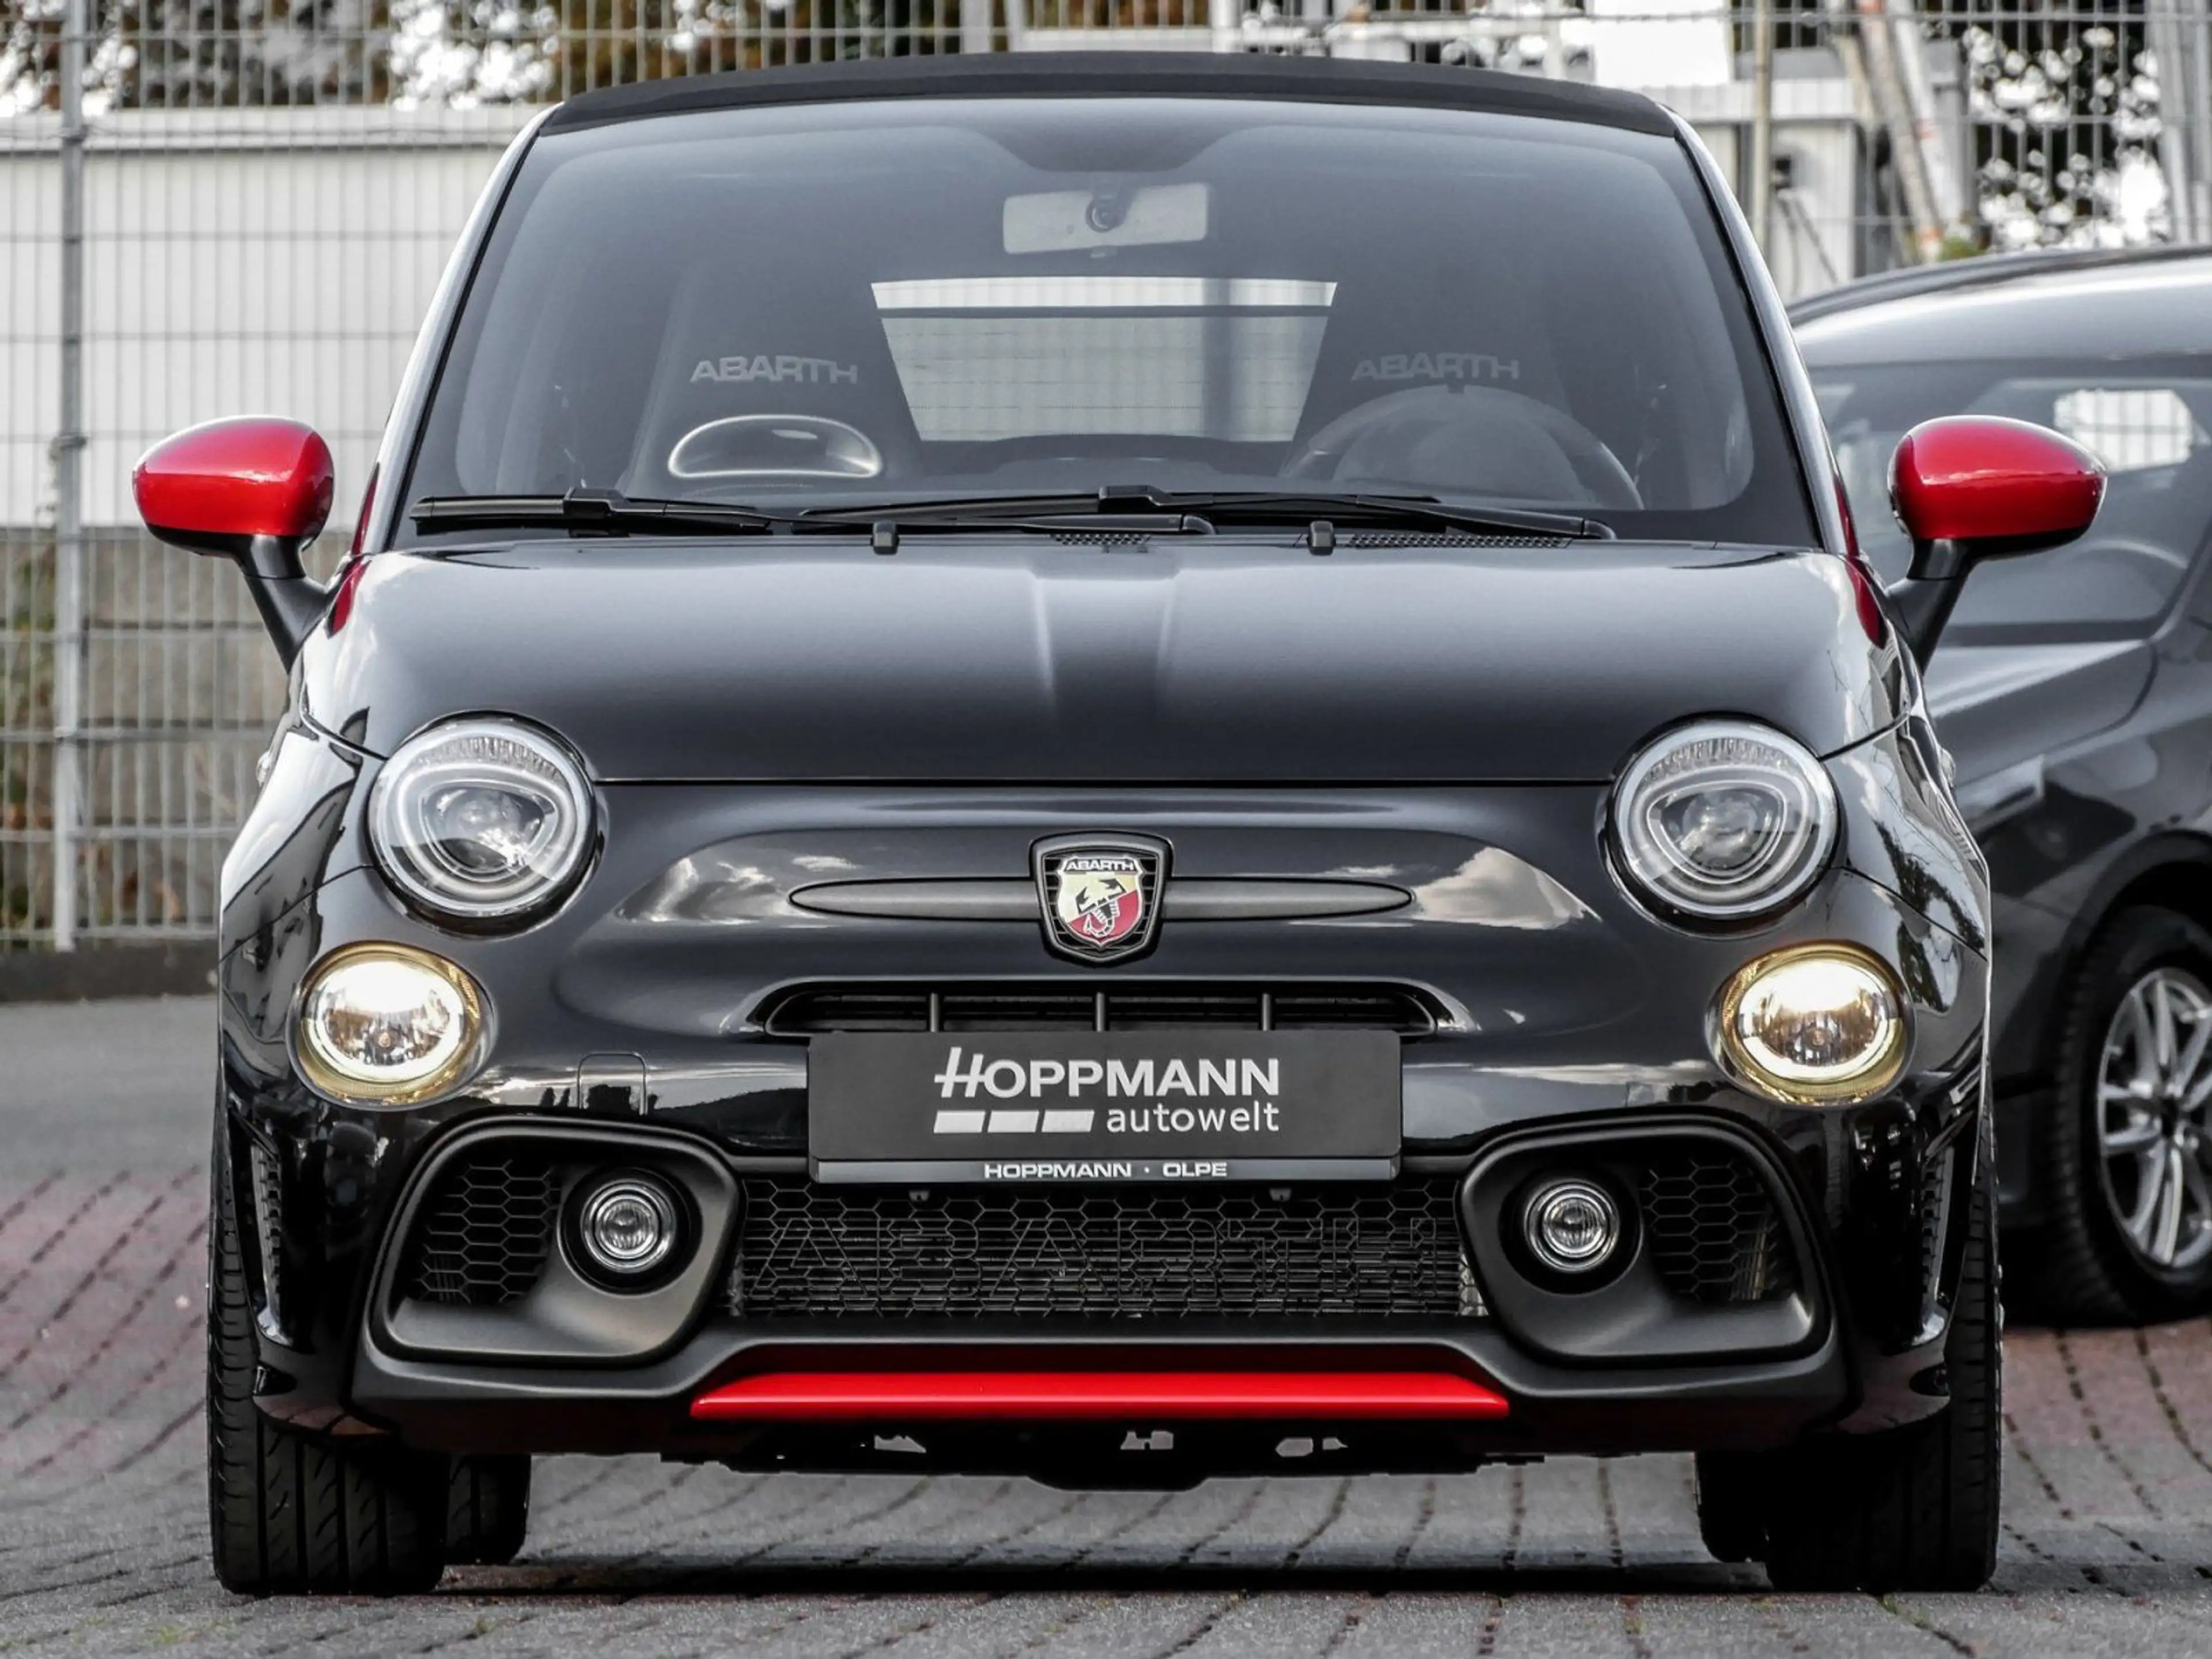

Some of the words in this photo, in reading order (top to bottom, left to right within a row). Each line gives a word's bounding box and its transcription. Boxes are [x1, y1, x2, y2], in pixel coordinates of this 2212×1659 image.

[690, 355, 858, 384] ABARTH
[1351, 351, 1520, 381] ABARTH
[1066, 859, 1133, 870] ABARTH
[934, 1046, 1279, 1099] HOPPMANN
[1107, 1100, 1279, 1133] autowelt
[984, 1162, 1132, 1179] HOPPMANN
[1162, 1161, 1228, 1177] OLPE
